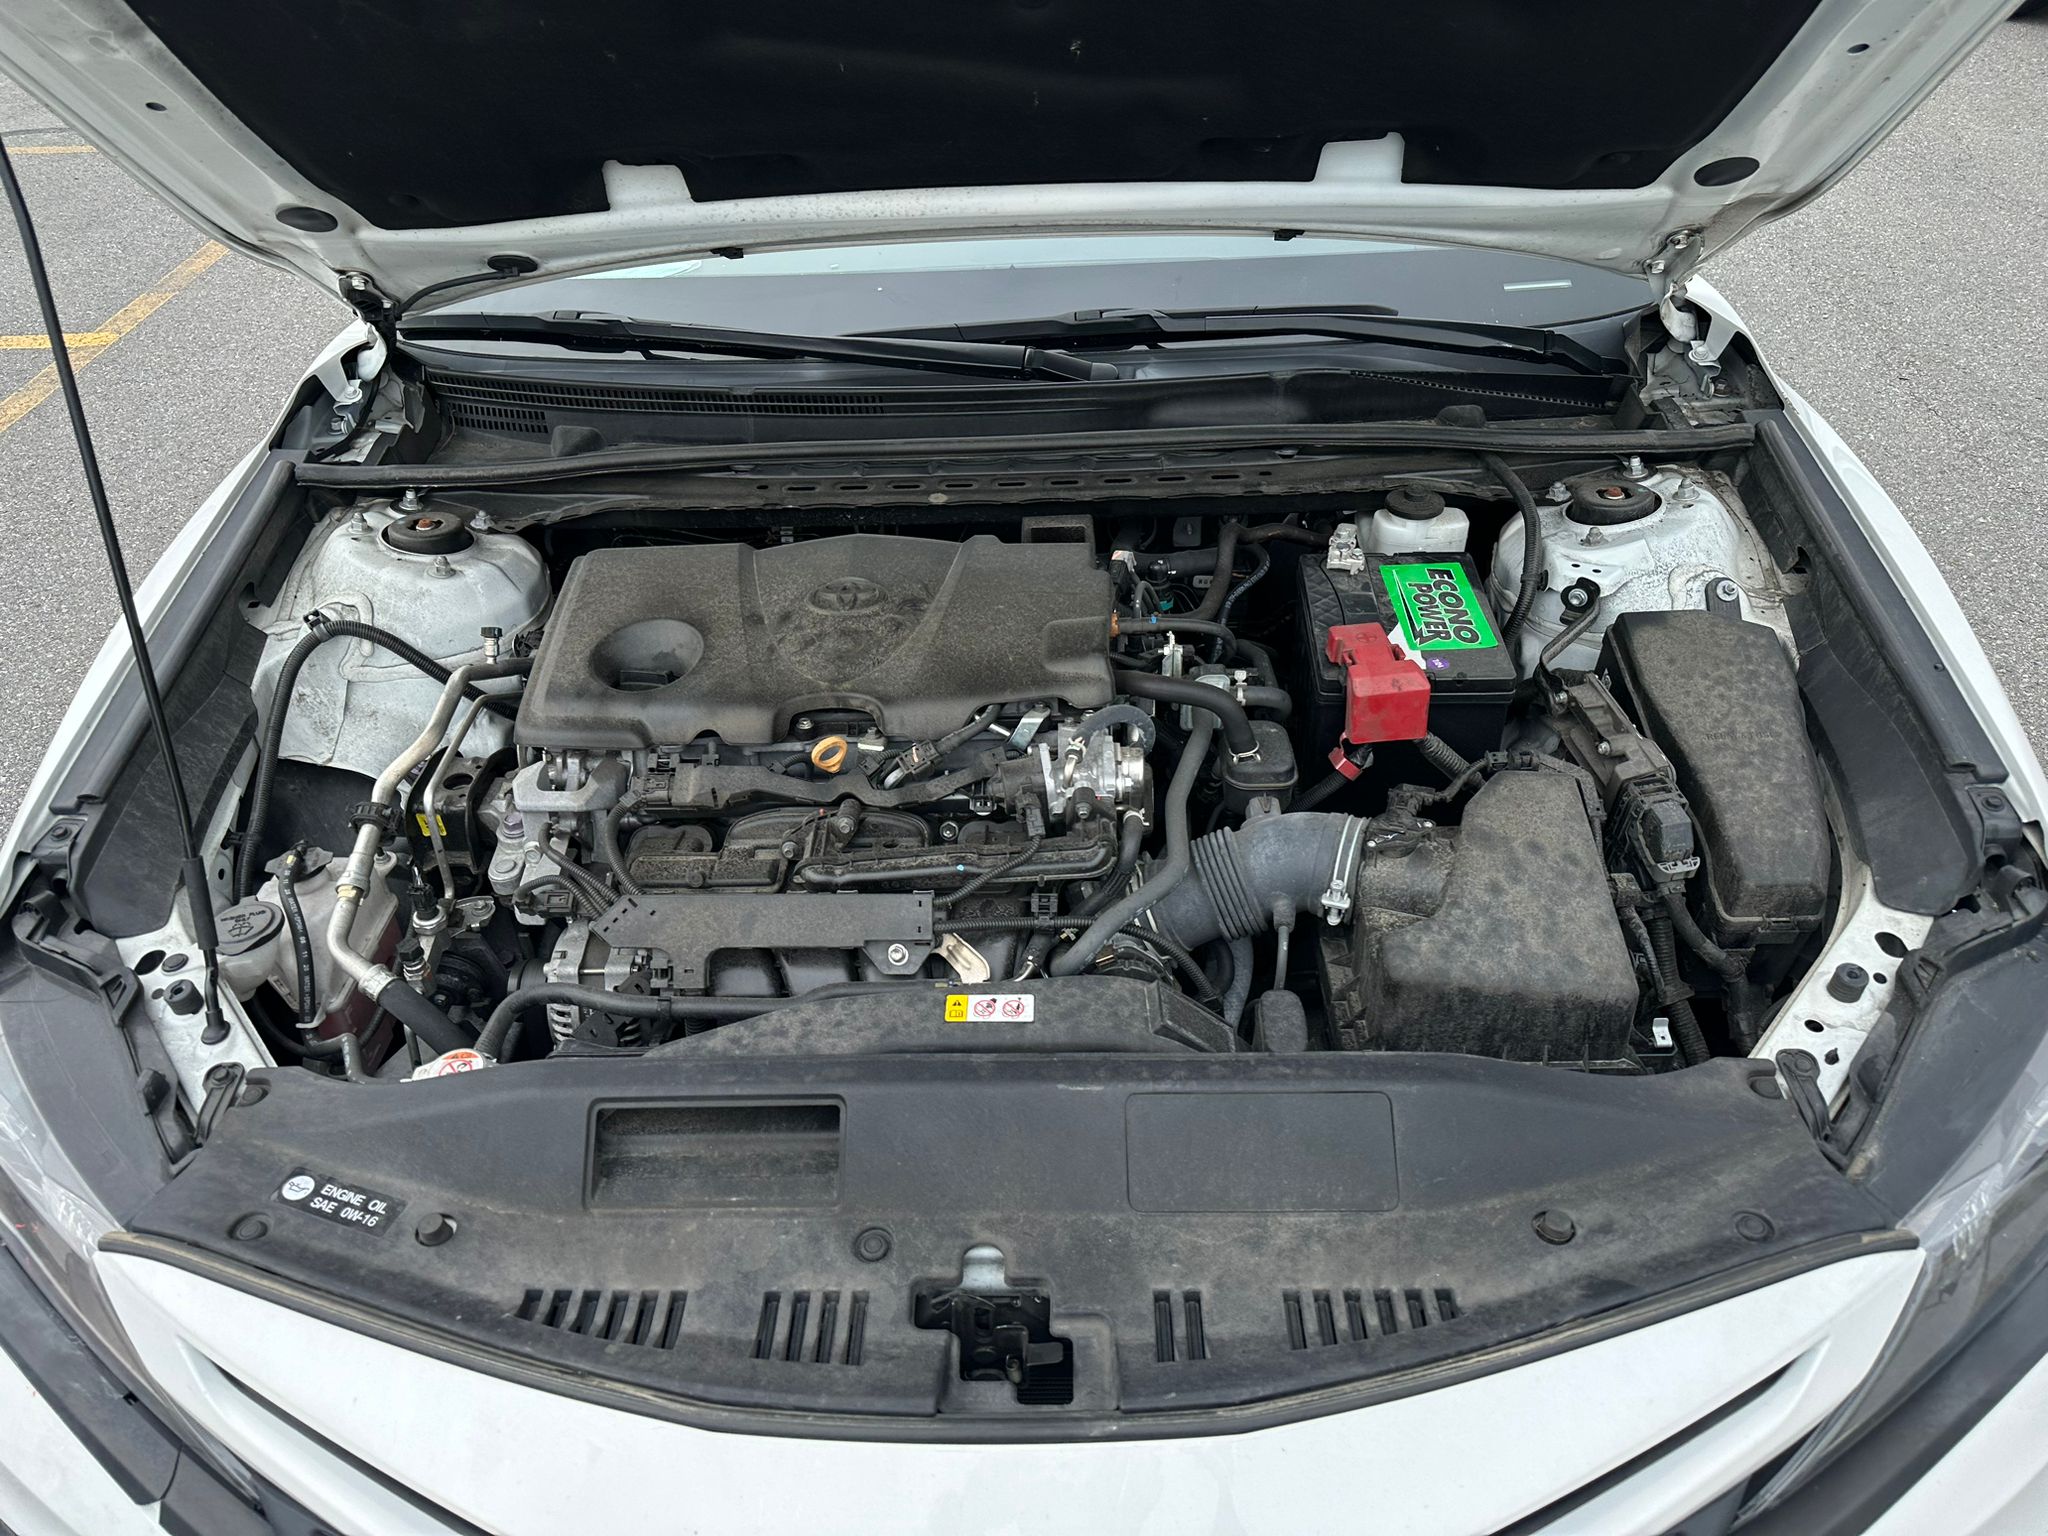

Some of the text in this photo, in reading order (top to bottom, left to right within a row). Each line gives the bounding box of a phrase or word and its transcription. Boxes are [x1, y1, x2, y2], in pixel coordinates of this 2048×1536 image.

[1407, 582, 1452, 646] POWER
[1425, 568, 1481, 645] ECONO
[310, 1196, 379, 1228] SAE 0W-16
[320, 1184, 388, 1214] ENGINE OIL
